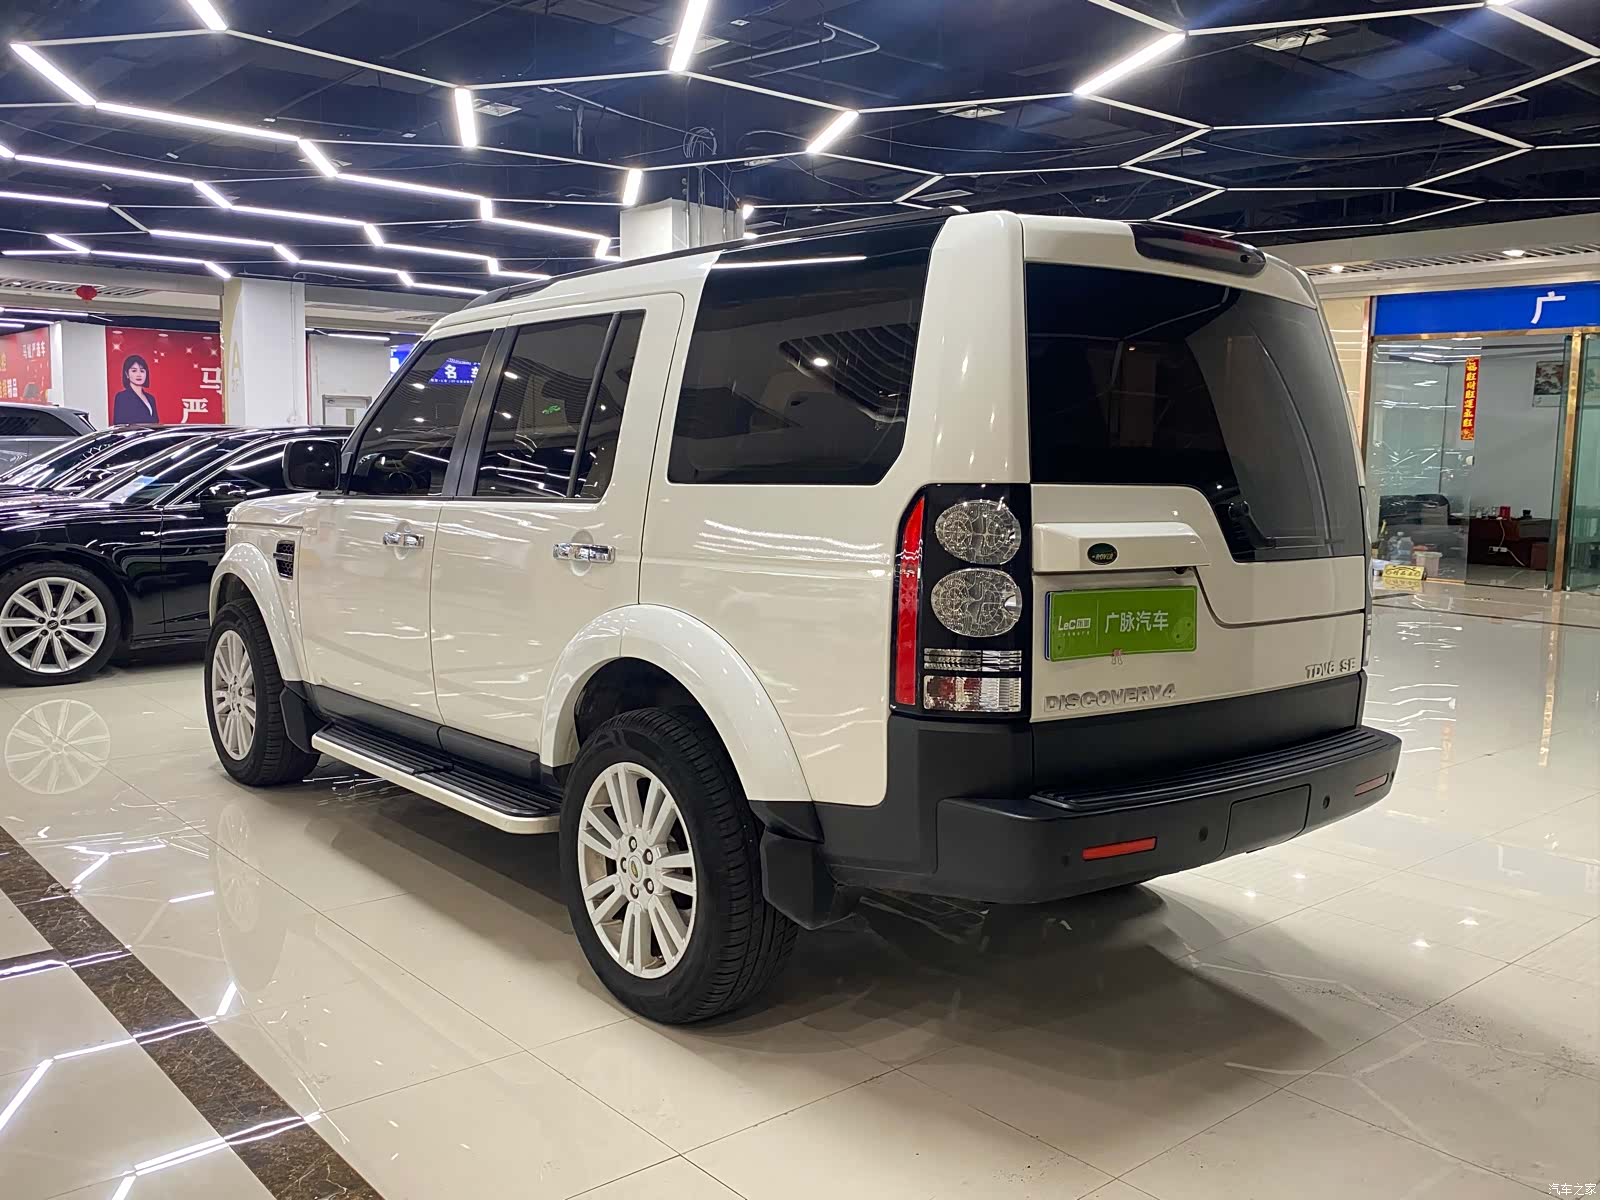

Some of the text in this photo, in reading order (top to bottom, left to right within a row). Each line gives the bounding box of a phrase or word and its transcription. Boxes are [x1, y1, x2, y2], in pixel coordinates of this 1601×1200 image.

[1531, 290, 1566, 325] 广
[180, 397, 209, 424] 严
[1104, 610, 1169, 634] 广脉汽车
[1340, 657, 1357, 672] SE
[1043, 683, 1177, 712] DISCOVERY 4
